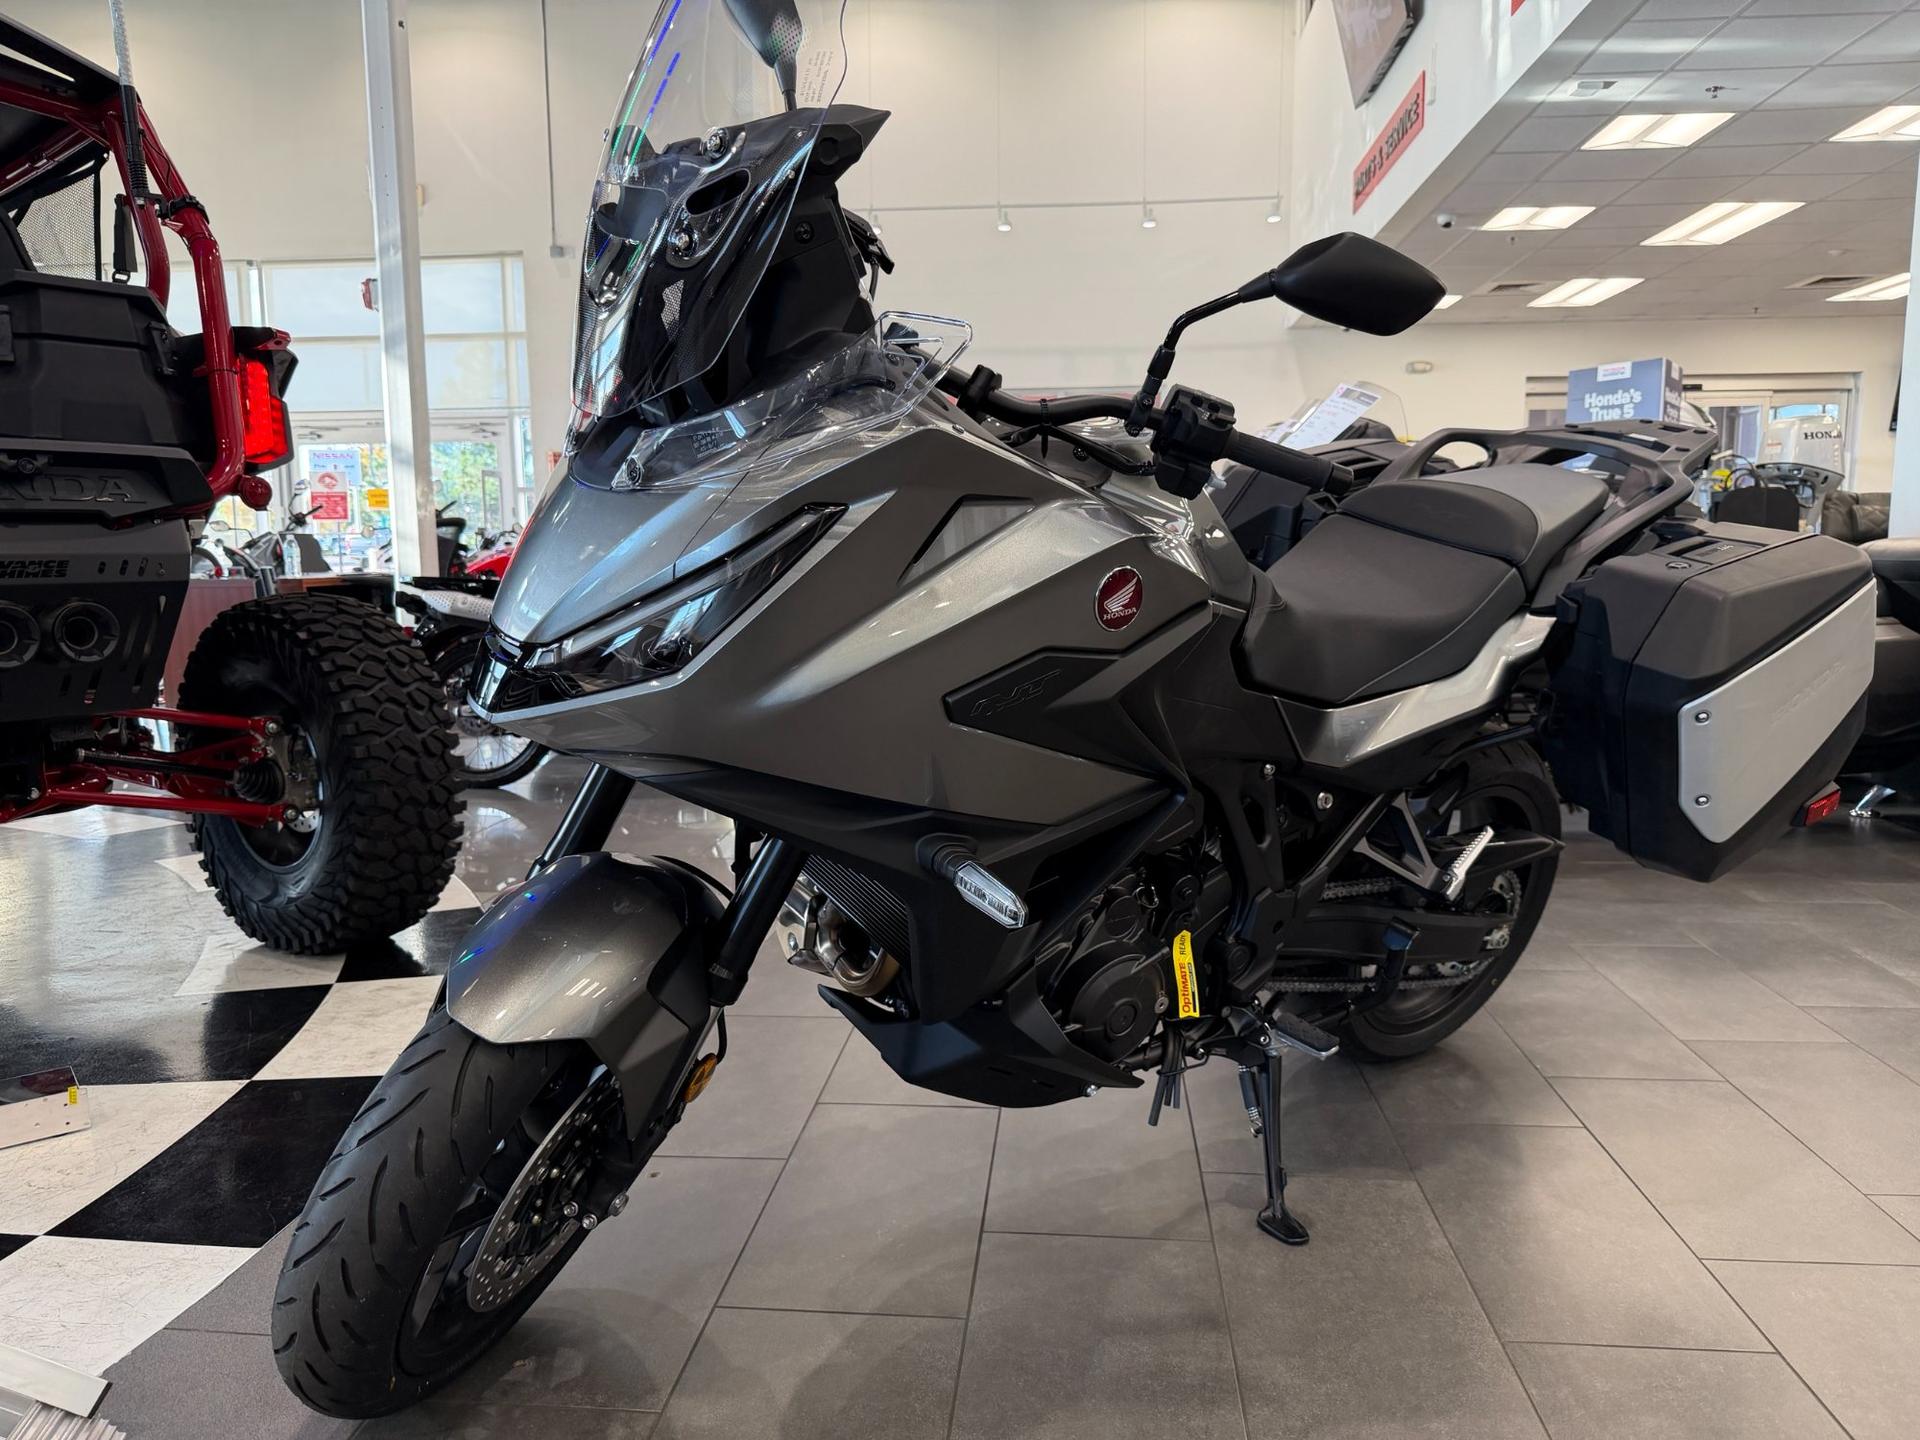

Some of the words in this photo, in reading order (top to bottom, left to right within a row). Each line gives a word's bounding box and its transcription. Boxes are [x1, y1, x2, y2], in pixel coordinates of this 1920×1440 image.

[1584, 388, 1642, 408] Honda's
[1589, 405, 1621, 422] True
[1103, 607, 1137, 620] HONDA
[1179, 935, 1187, 955] READY
[1179, 963, 1192, 1013] OptiMATE
